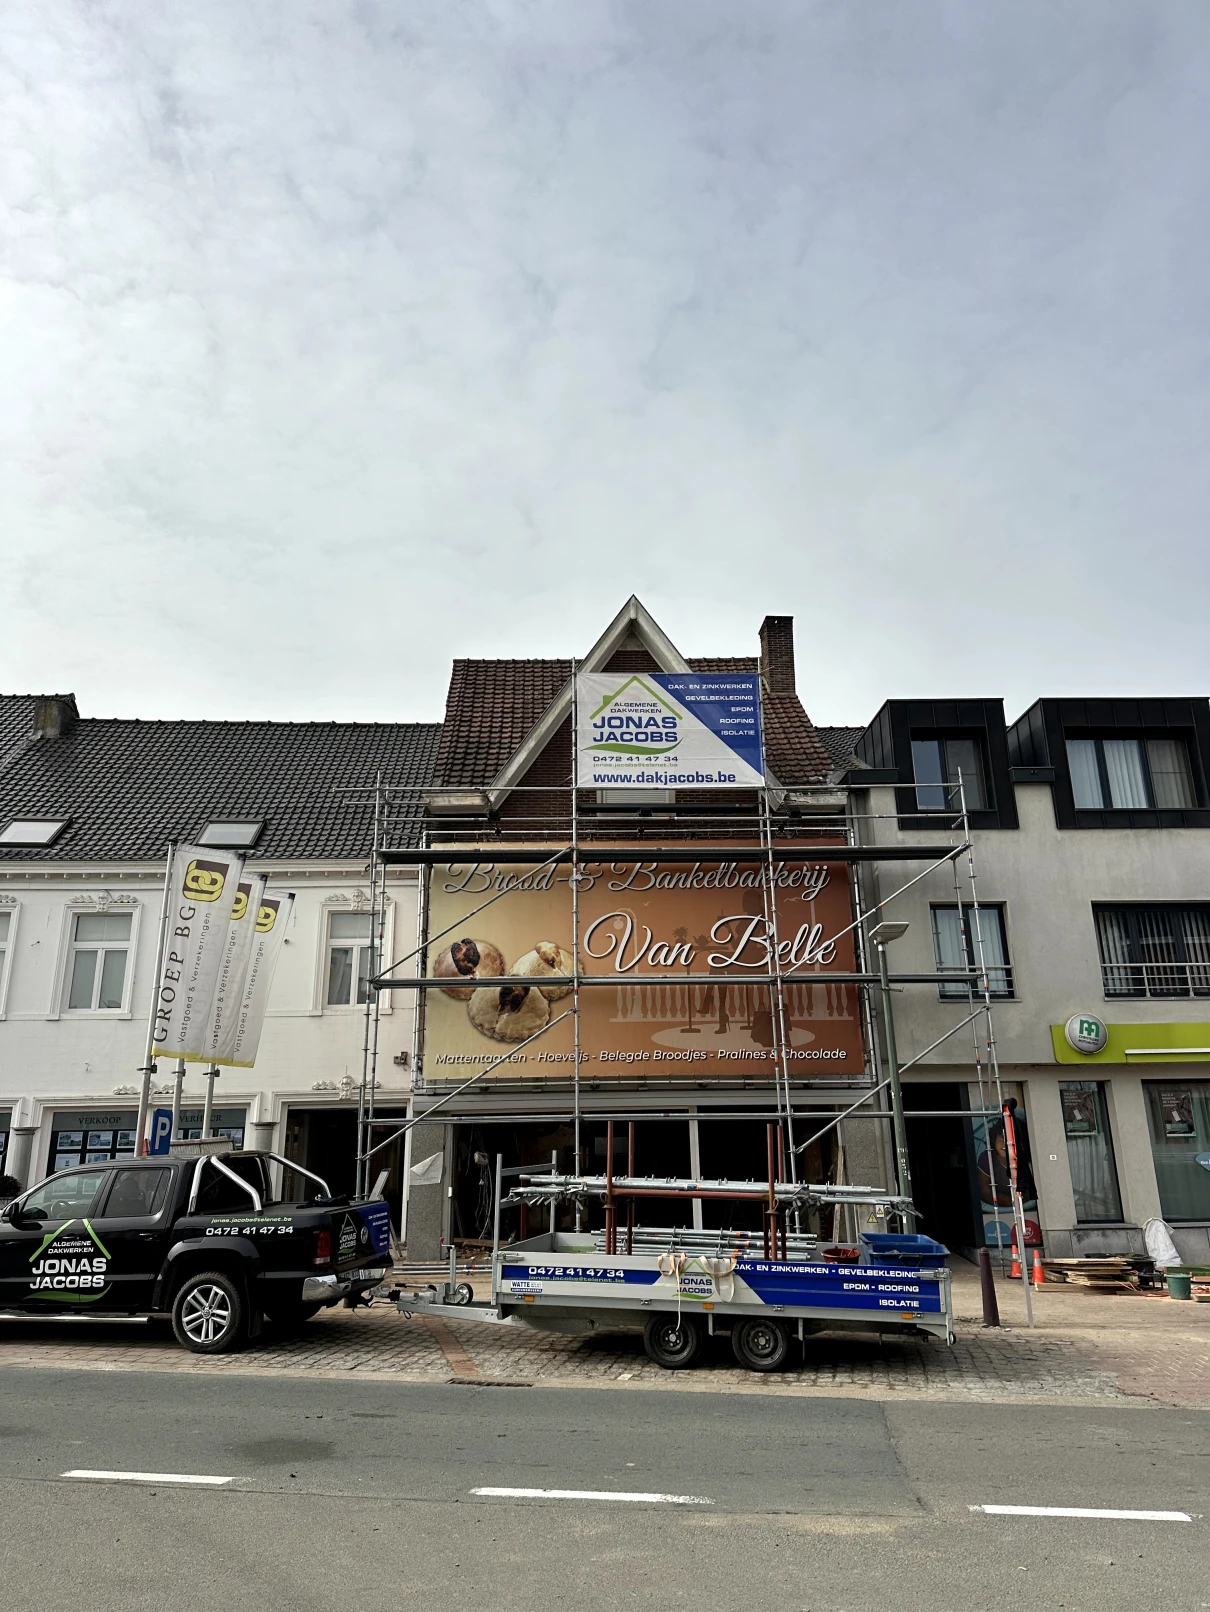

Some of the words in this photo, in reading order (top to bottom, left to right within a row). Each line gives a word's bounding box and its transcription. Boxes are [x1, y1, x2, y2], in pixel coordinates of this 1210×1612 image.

[592, 716, 678, 729] JONAS
[592, 731, 678, 743] JACOBS
[592, 771, 737, 786] www.dakjacobs.be
[608, 862, 831, 901] Banketbakkerij
[583, 911, 697, 973] Van
[707, 913, 837, 968] Belle
[153, 951, 184, 1043] GROEP
[174, 905, 197, 939] BG
[177, 997, 193, 1044] Vastgoed
[191, 912, 211, 982] Verzekeringen
[210, 1006, 223, 1050] Vastgoed
[219, 930, 237, 994] Verzekeringen
[234, 1012, 248, 1053] Vastgoed
[246, 941, 266, 1000] Verzekeringen
[537, 1051, 589, 1064] Hoevejs
[599, 1050, 650, 1063] Belegde
[653, 1049, 707, 1062] Broodjes
[717, 1048, 767, 1060] Pralines
[78, 1116, 122, 1125] VERKOOP
[179, 1114, 222, 1123] VERHUR
[154, 1116, 170, 1150] P
[205, 1227, 239, 1236] 0472
[242, 1226, 257, 1235] 41
[259, 1226, 276, 1235] 47
[277, 1226, 294, 1234] 34
[31, 1257, 107, 1274] JONAS
[528, 1266, 564, 1276] 0472
[566, 1268, 583, 1276] 41
[586, 1268, 604, 1277] 47
[606, 1269, 625, 1278] 34
[771, 1265, 829, 1274] ZINKWERKEN
[29, 1275, 105, 1289] JACOBS
[843, 1283, 870, 1291] EPDM
[878, 1284, 920, 1293] ROOFING
[879, 1299, 920, 1308] ISOLATIE
